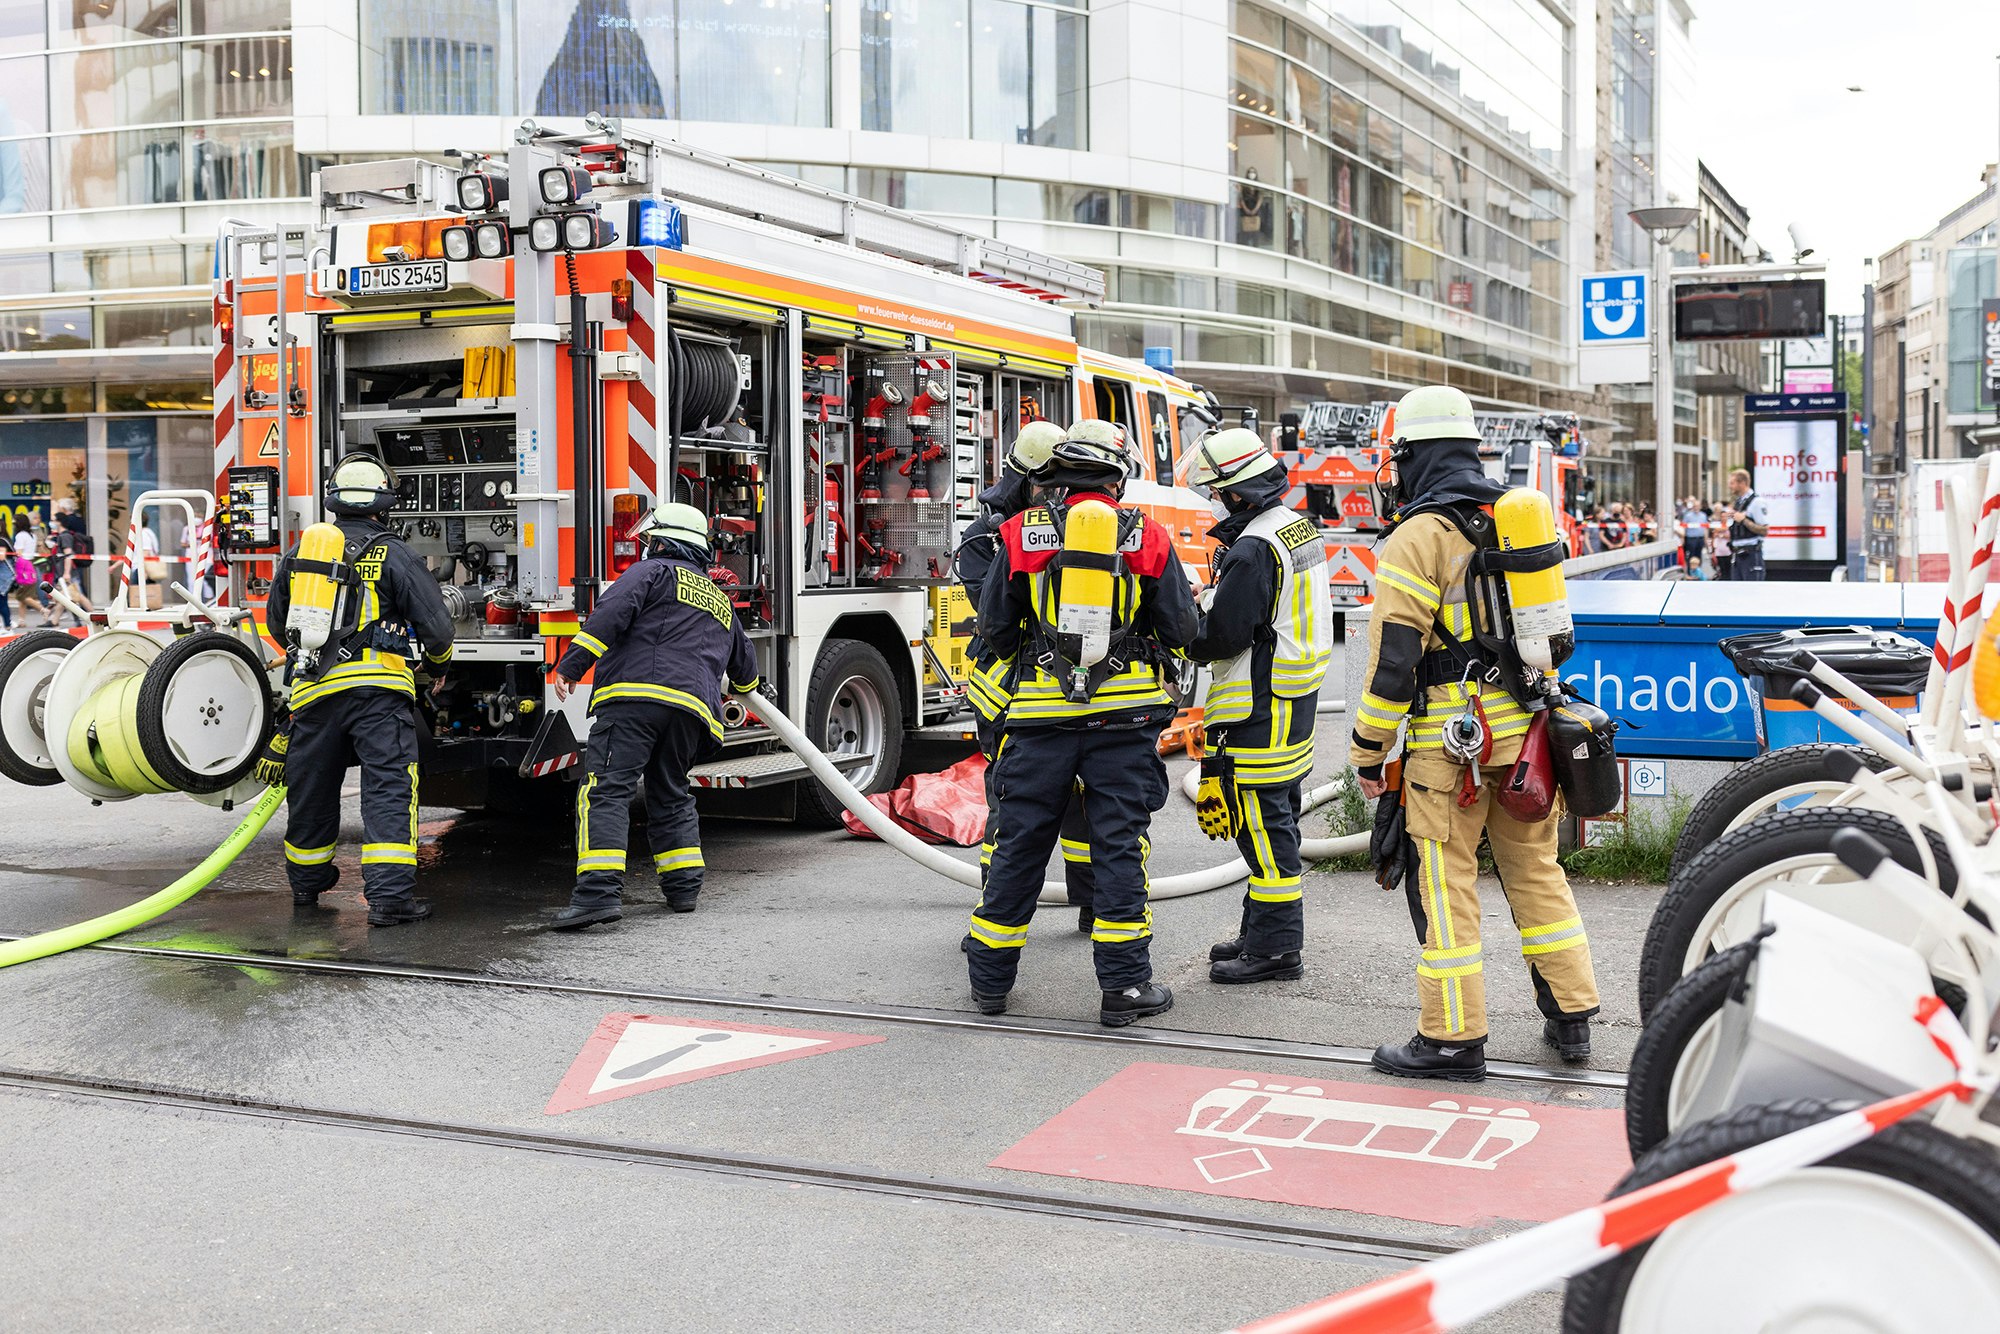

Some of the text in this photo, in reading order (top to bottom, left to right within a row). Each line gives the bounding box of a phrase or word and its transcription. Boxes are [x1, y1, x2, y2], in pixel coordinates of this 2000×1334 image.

[361, 265, 442, 288] D US 2545
[857, 303, 955, 332] www.feuerwehr-duesseldorf.de
[1155, 412, 1168, 461] 3
[12, 484, 50, 495] BIS ZU
[680, 587, 731, 626] DÜSSELDORF
[951, 591, 967, 601] EISE
[1640, 772, 1649, 784] B
